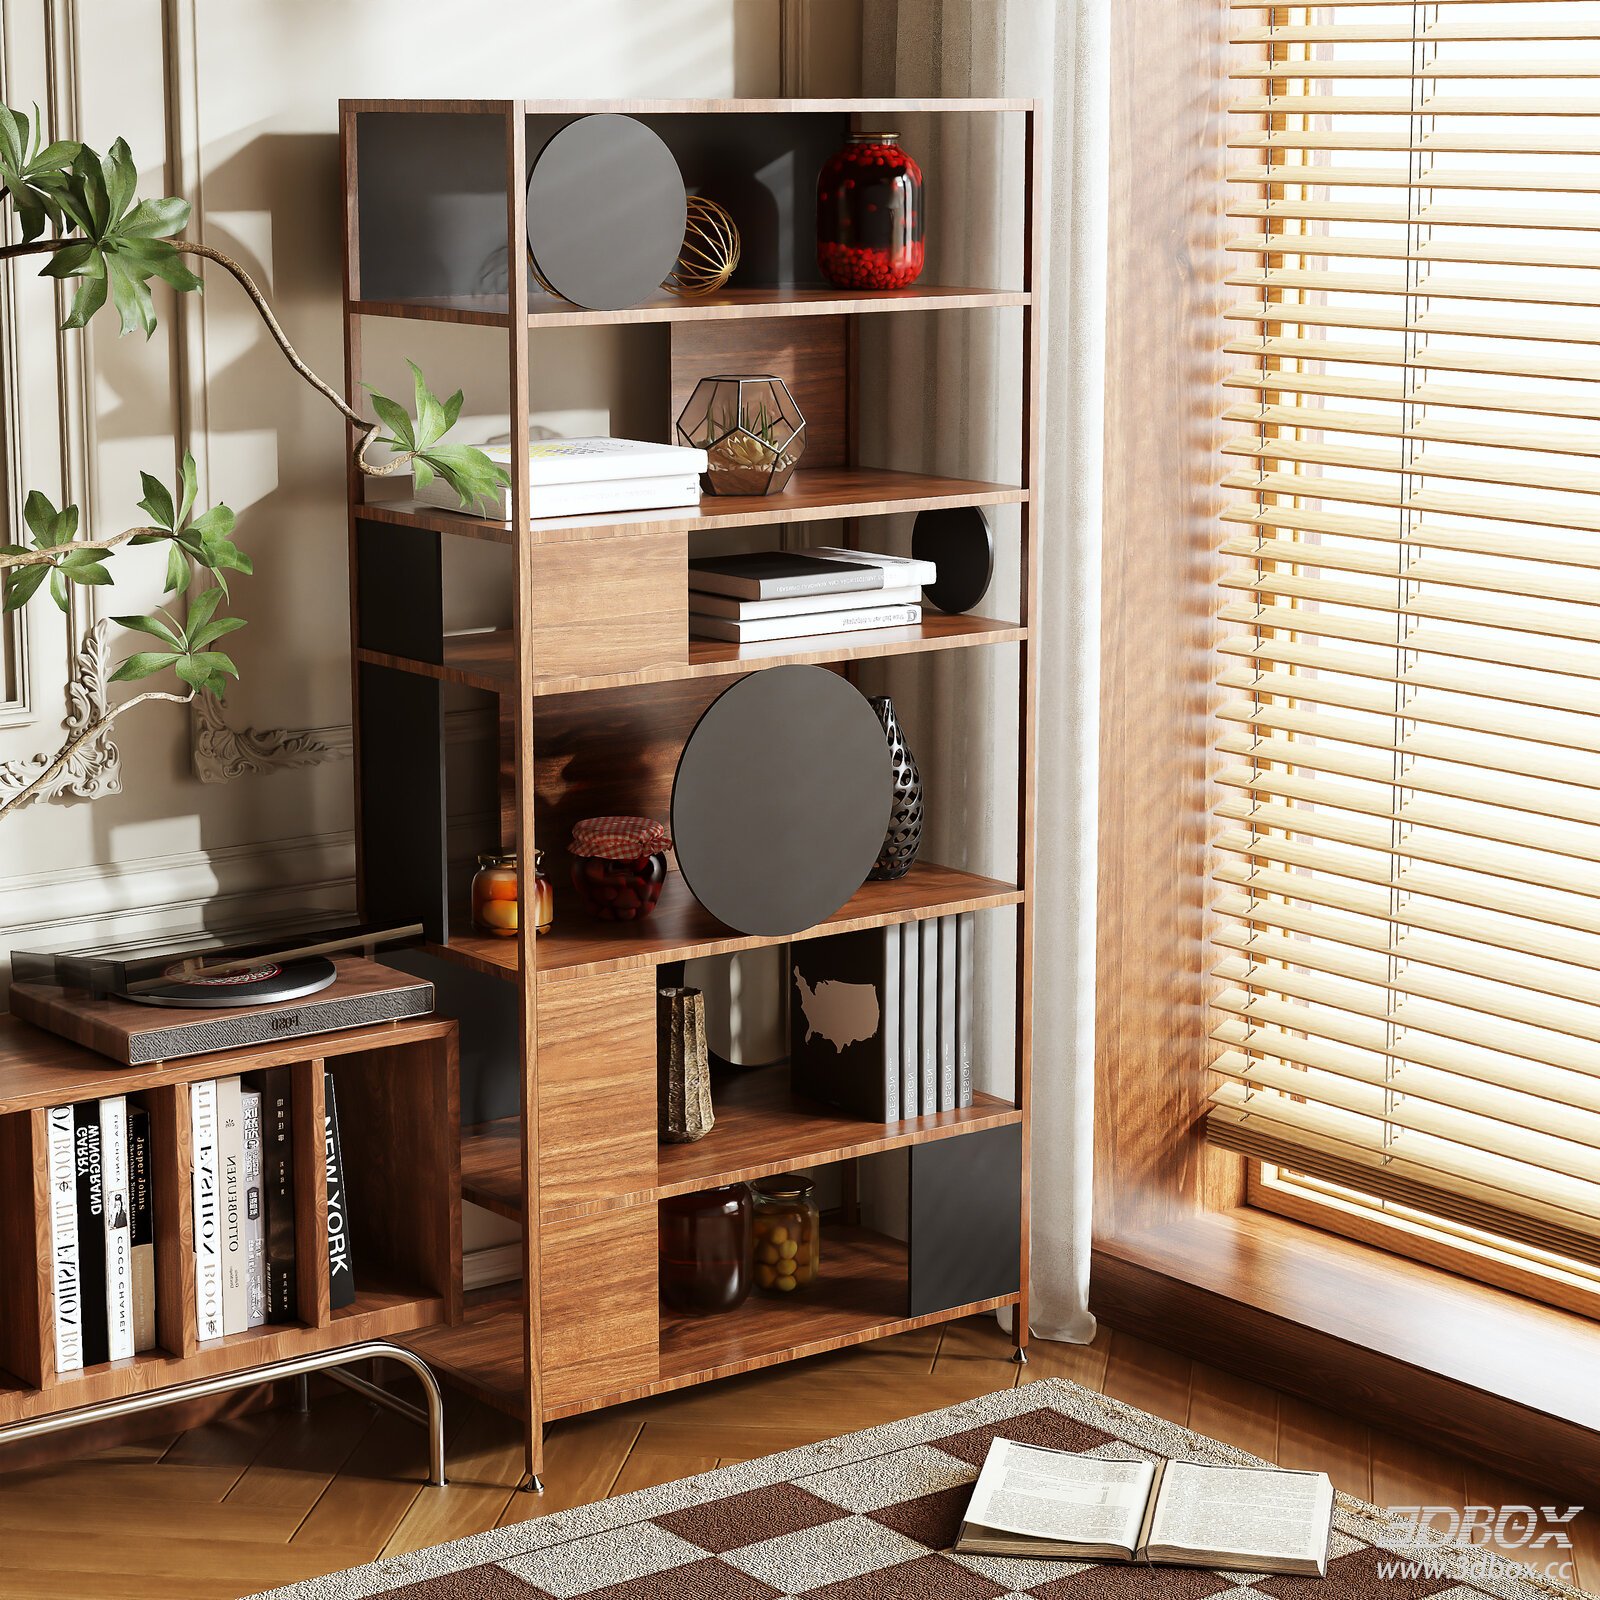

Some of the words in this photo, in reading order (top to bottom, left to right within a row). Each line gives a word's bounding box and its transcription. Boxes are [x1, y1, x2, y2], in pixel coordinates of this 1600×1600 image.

[135, 1136, 145, 1175] Jasper
[325, 1116, 338, 1183] NEW
[137, 1177, 147, 1210] Johns
[327, 1190, 349, 1277] YORK
